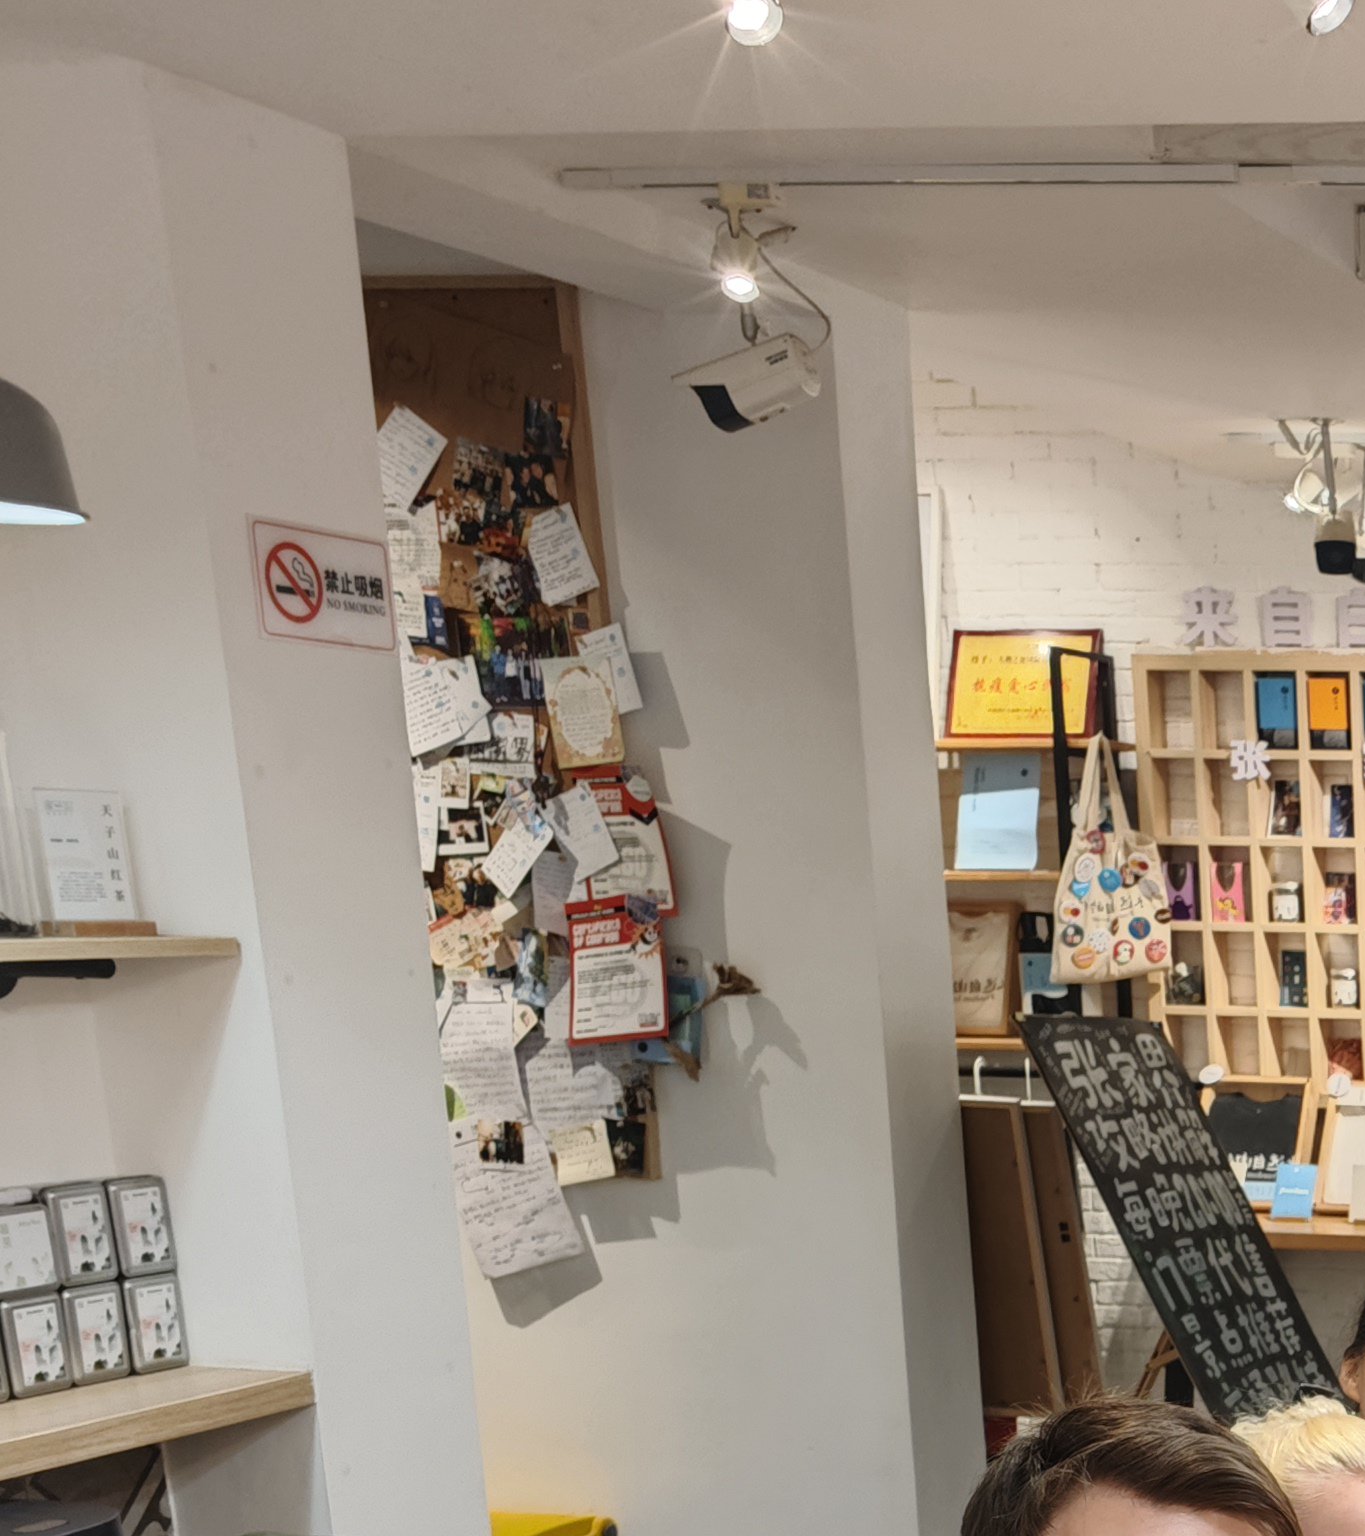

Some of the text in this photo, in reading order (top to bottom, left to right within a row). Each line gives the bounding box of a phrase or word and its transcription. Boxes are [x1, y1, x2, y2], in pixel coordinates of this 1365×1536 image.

[324, 569, 384, 600] 禁止吸烟
[326, 598, 386, 617] NO SMOKING
[1053, 1033, 1184, 1110] 张家界
[1084, 1108, 1221, 1173] 攻略讲解
